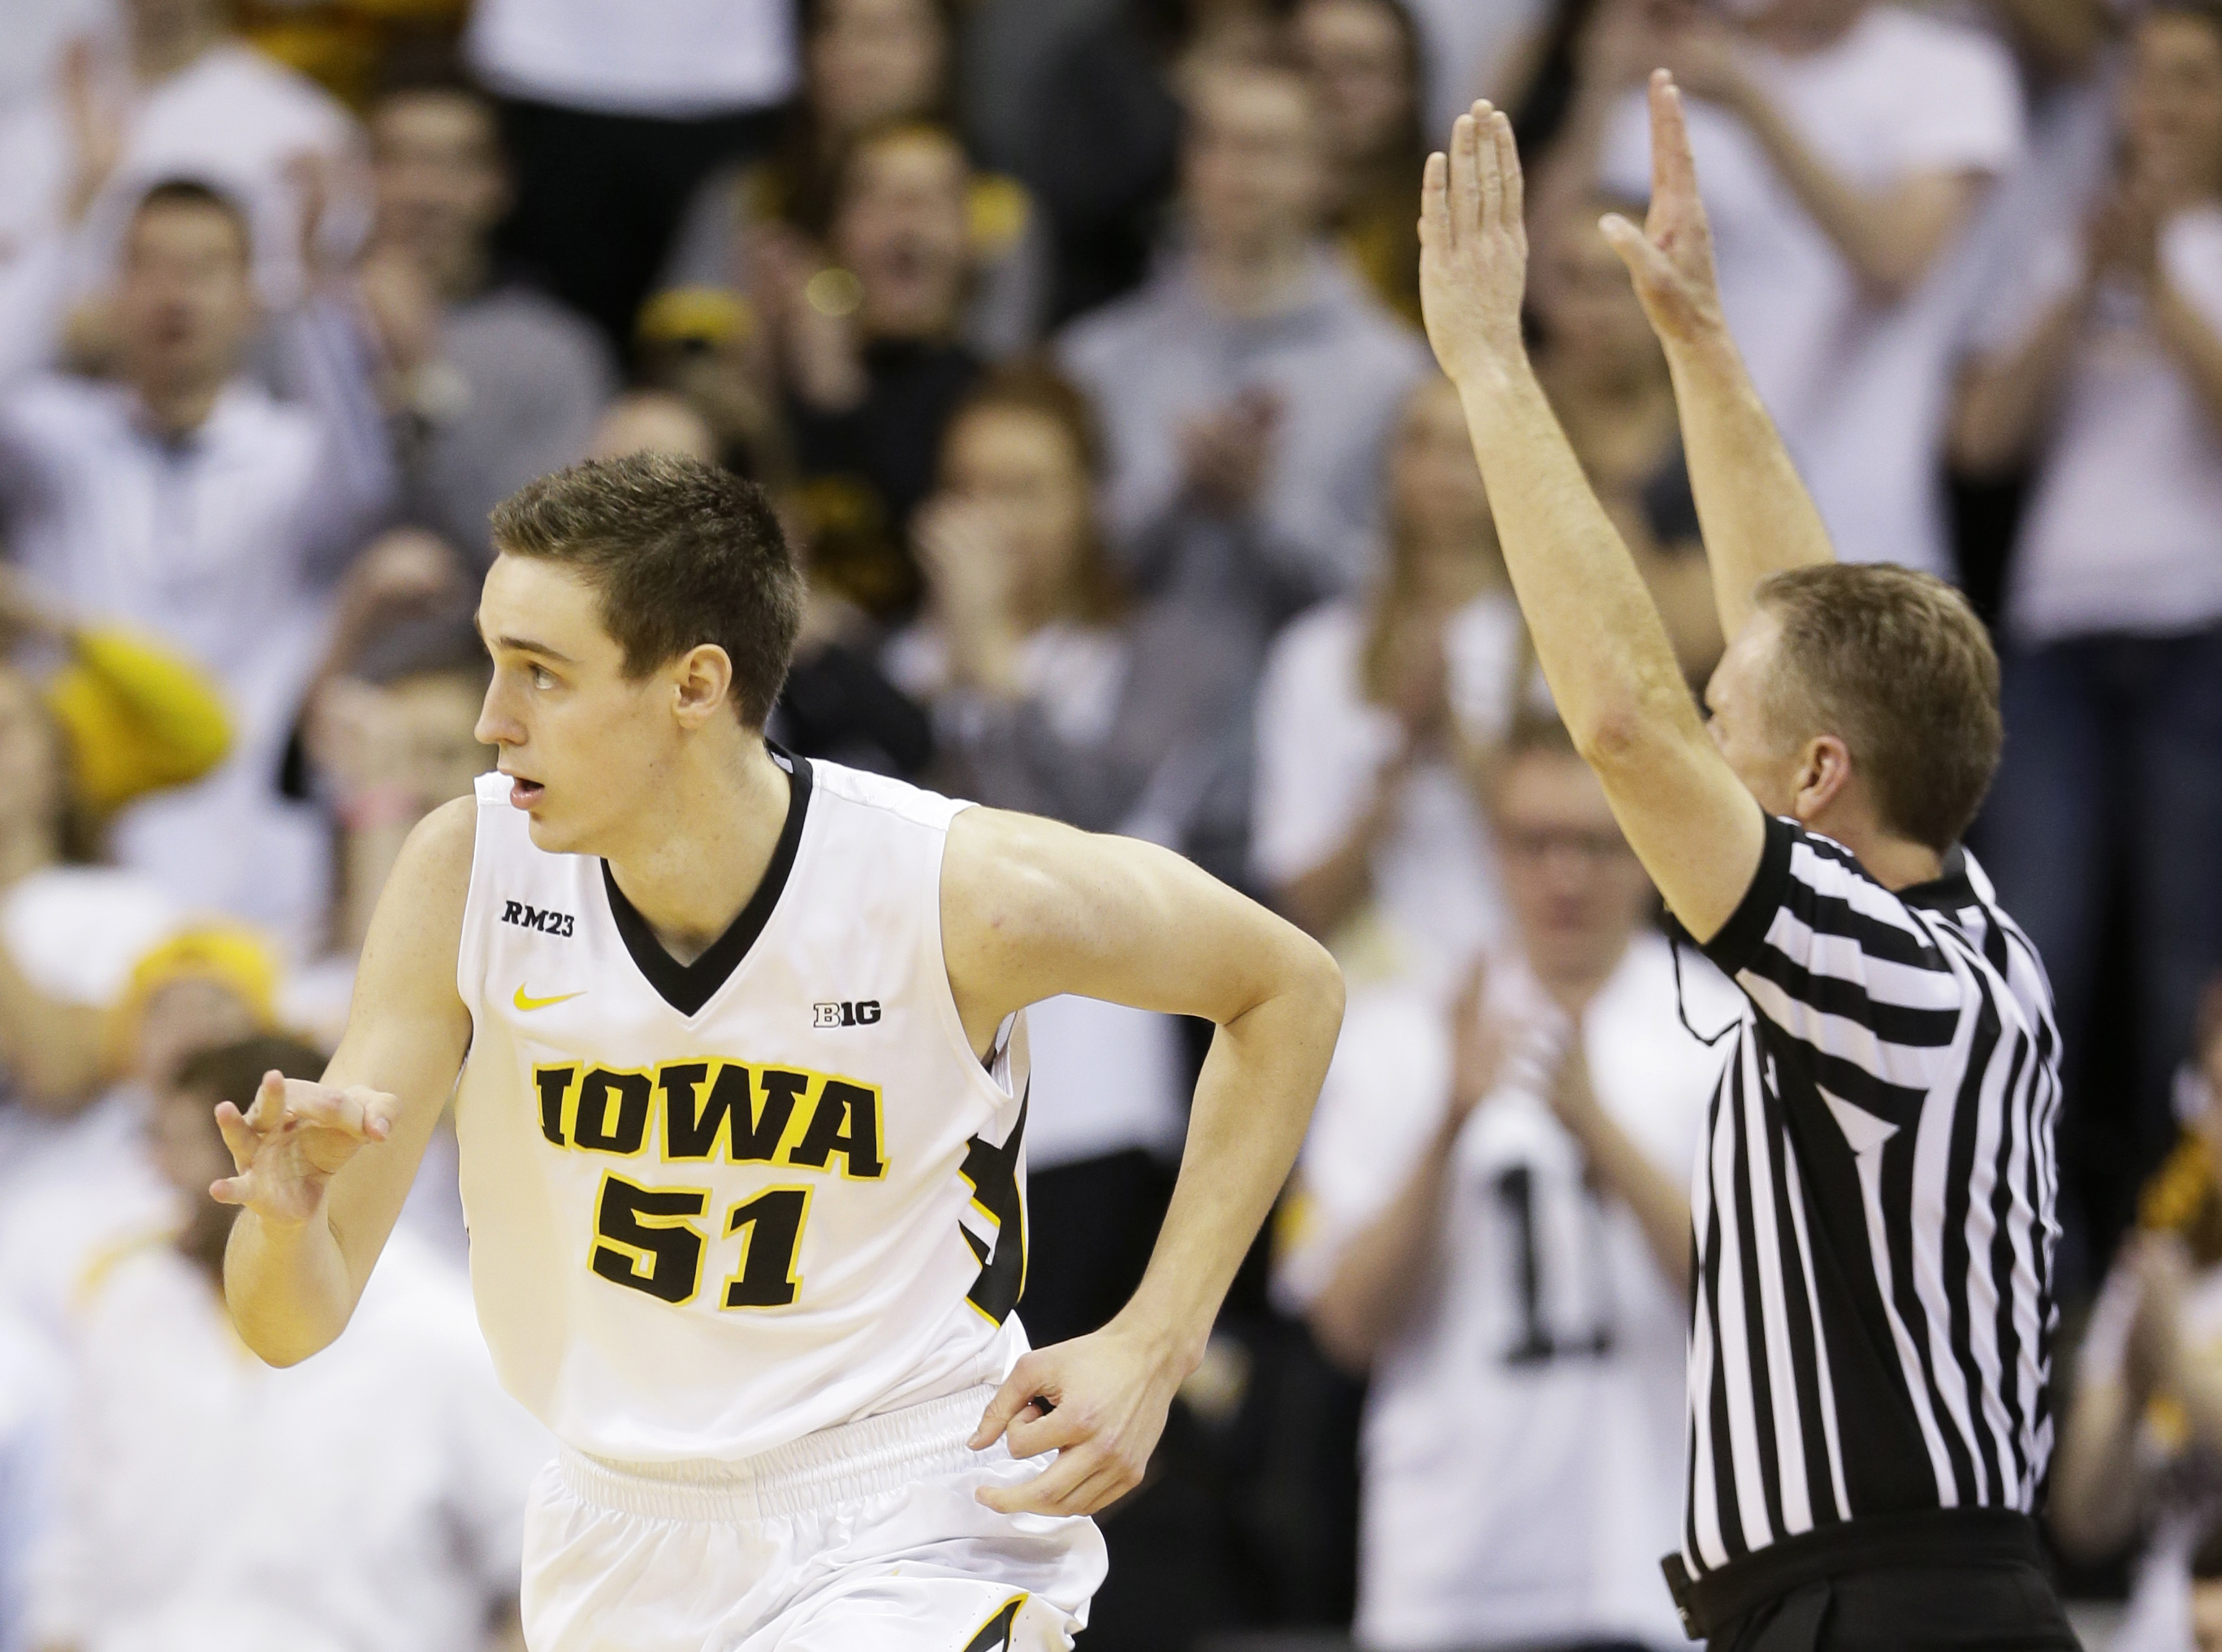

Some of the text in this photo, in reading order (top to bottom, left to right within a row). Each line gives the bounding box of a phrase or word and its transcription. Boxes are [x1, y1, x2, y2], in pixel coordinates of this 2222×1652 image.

[501, 900, 575, 938] RM23
[532, 1056, 891, 1180] IOWA
[587, 1168, 815, 1311] 51
